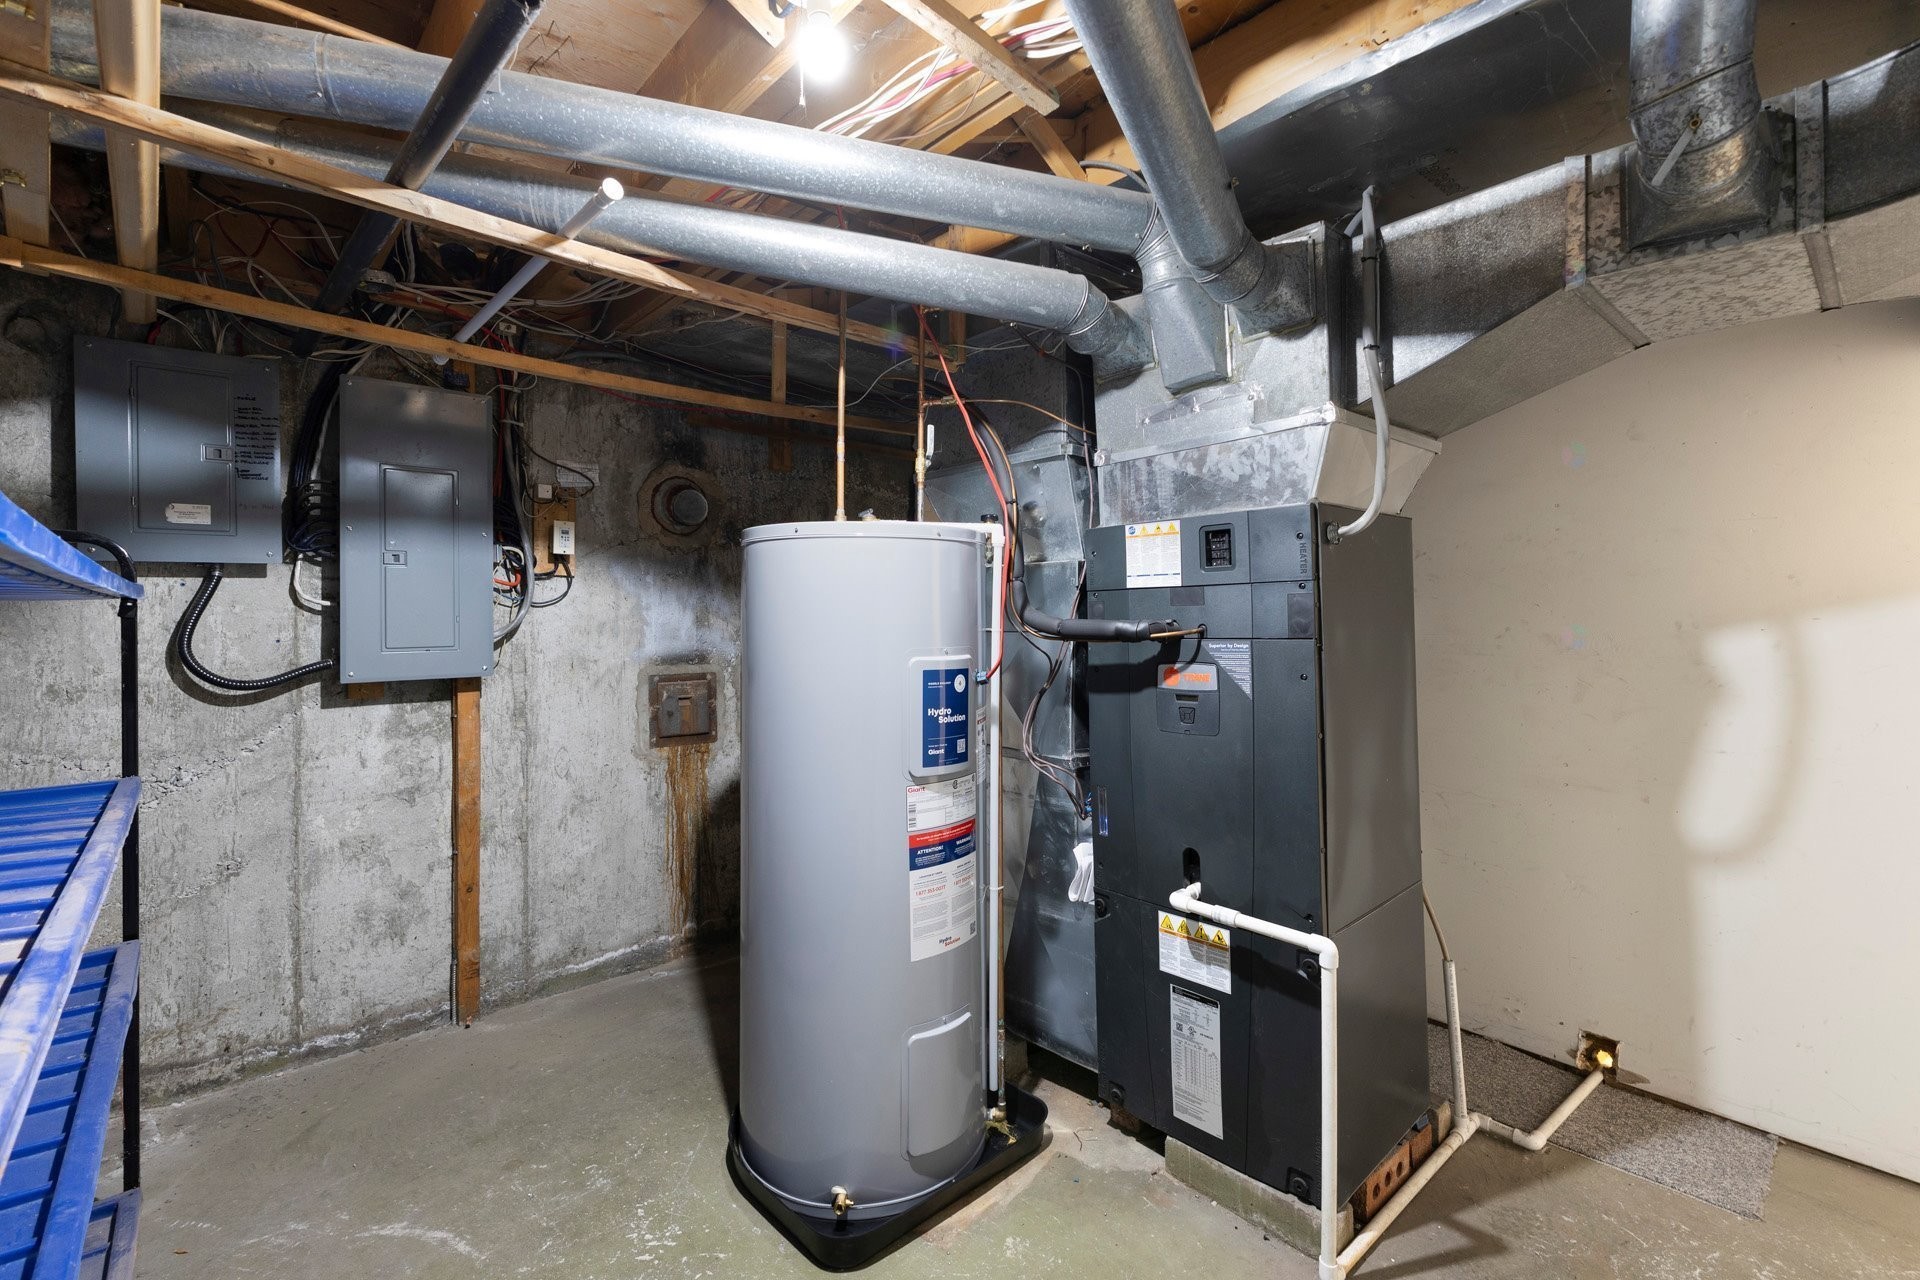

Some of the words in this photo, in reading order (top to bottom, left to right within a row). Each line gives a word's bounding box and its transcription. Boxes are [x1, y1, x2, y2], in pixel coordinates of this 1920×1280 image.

[1299, 542, 1308, 575] HEATER
[928, 708, 952, 717] Hydro
[938, 714, 966, 723] Solution
[907, 786, 925, 794] Giant
[939, 936, 952, 944] Hydro
[944, 936, 961, 947] Solution
